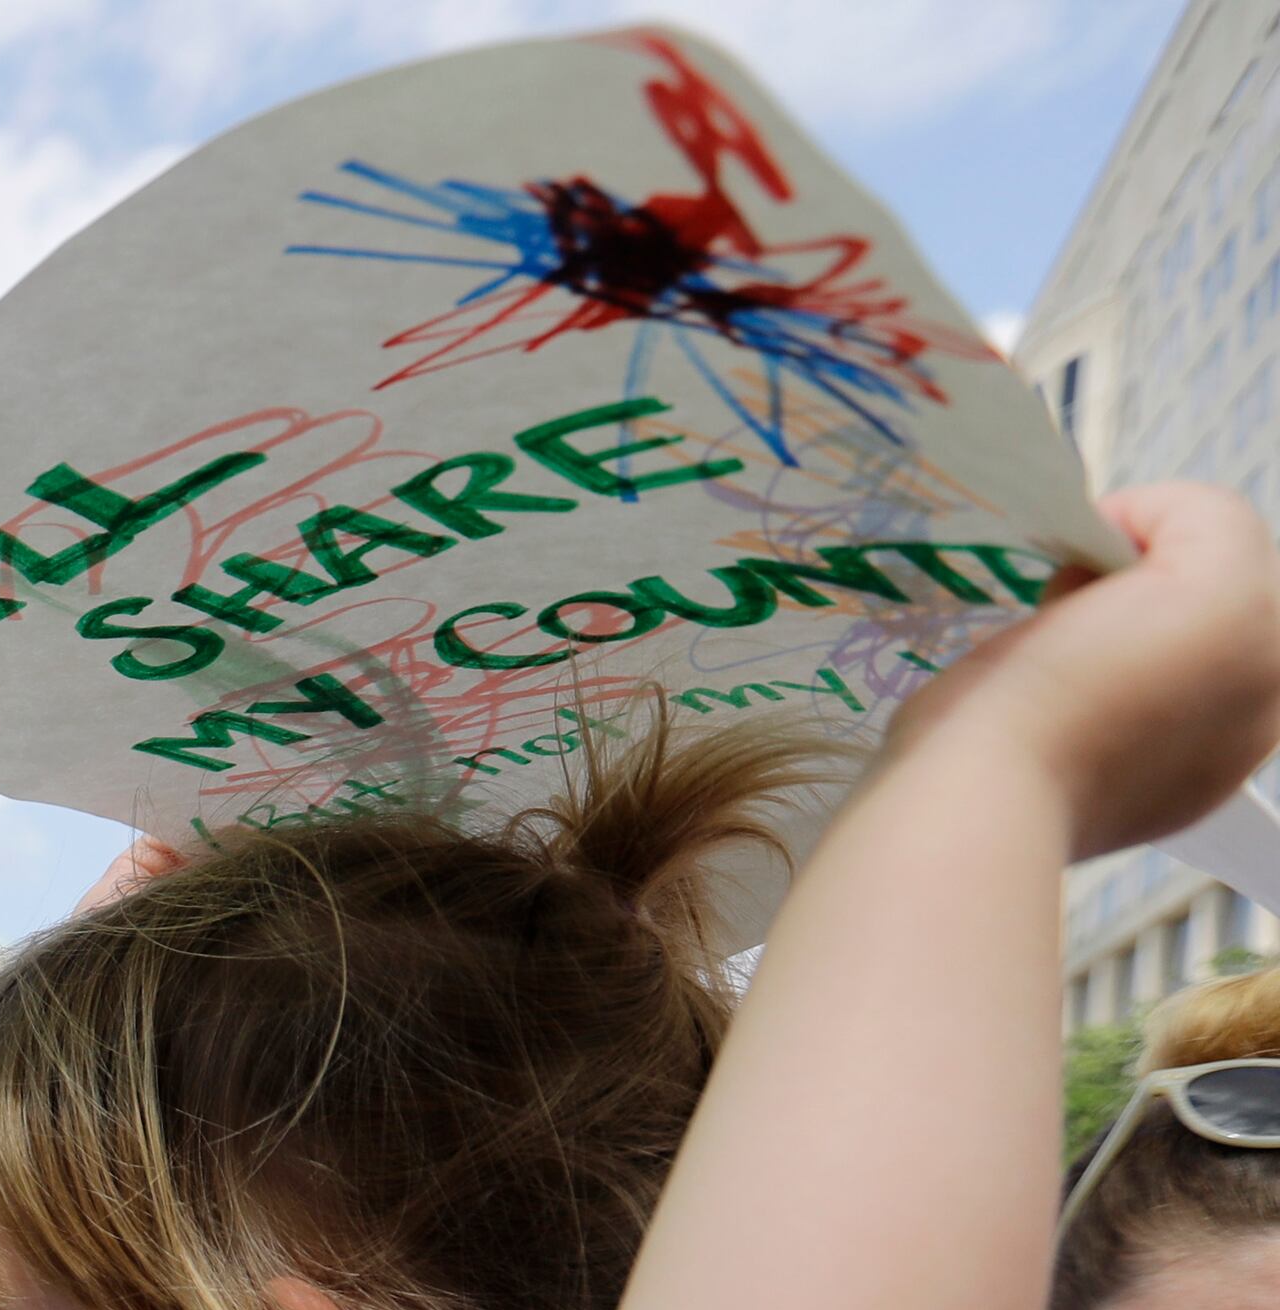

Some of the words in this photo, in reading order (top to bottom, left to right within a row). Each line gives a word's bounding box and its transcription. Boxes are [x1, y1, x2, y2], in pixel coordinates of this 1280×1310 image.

[74, 396, 745, 681] SHARE
[131, 672, 386, 772] MY
[669, 668, 866, 714] my
